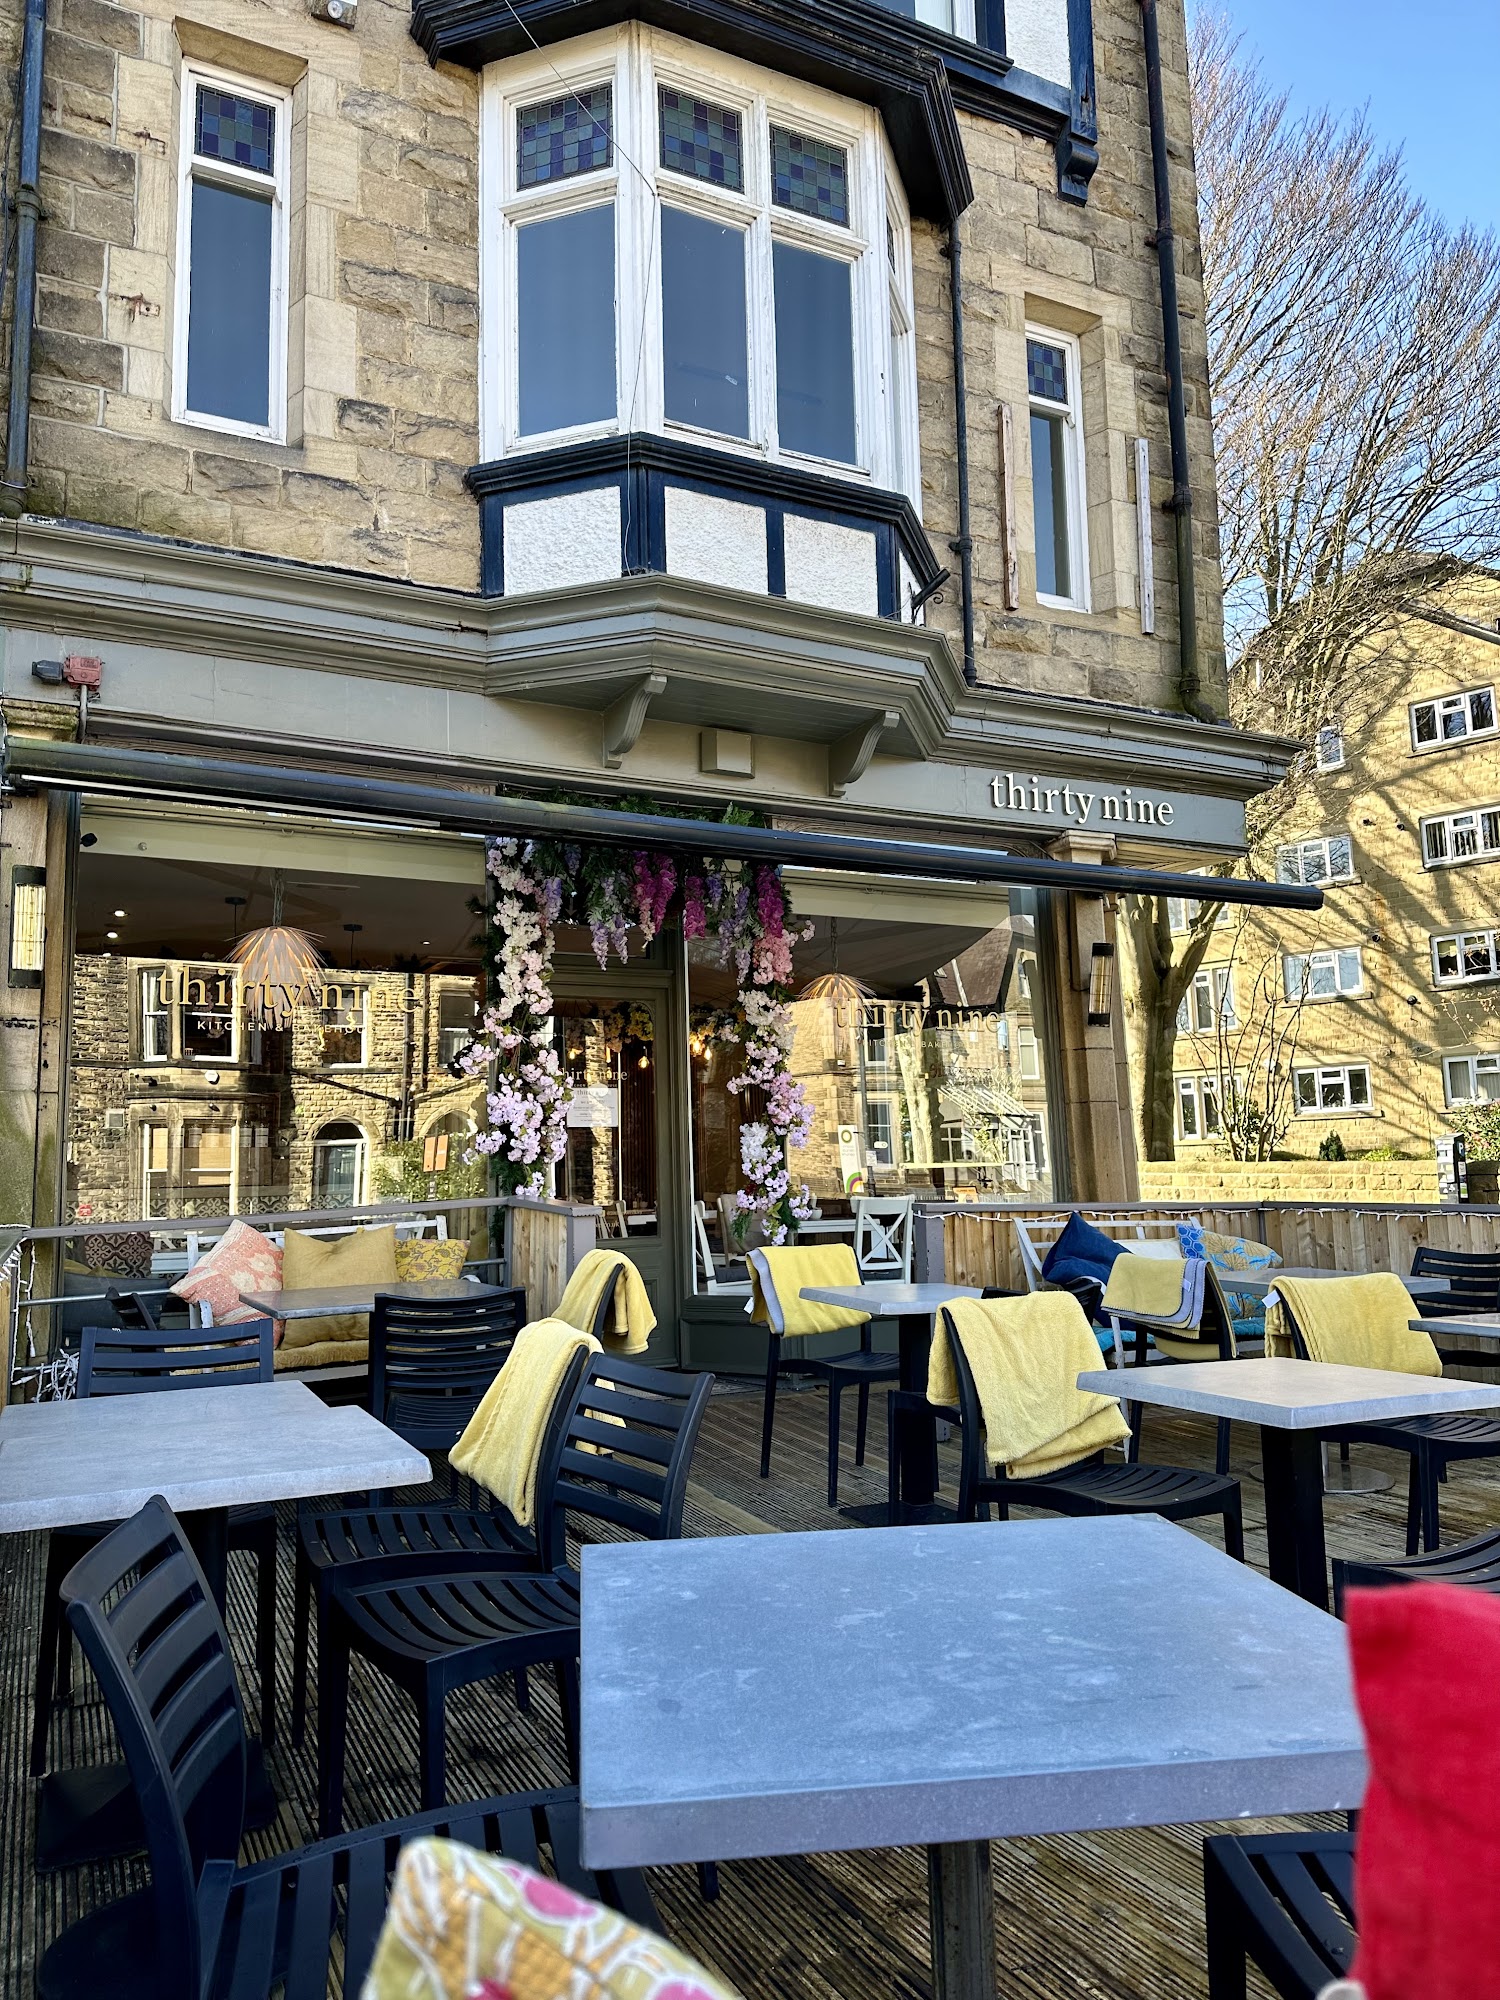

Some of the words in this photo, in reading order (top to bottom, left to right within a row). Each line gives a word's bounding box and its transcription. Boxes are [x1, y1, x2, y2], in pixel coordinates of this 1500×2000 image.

[990, 773, 1095, 824] thirty
[1103, 788, 1174, 826] nine
[157, 966, 308, 1017] thirty
[321, 974, 420, 1012] nine
[275, 1023, 284, 1031] &
[834, 998, 930, 1037] thirty
[935, 1001, 1001, 1033] nine
[1458, 1142, 1464, 1154] P
